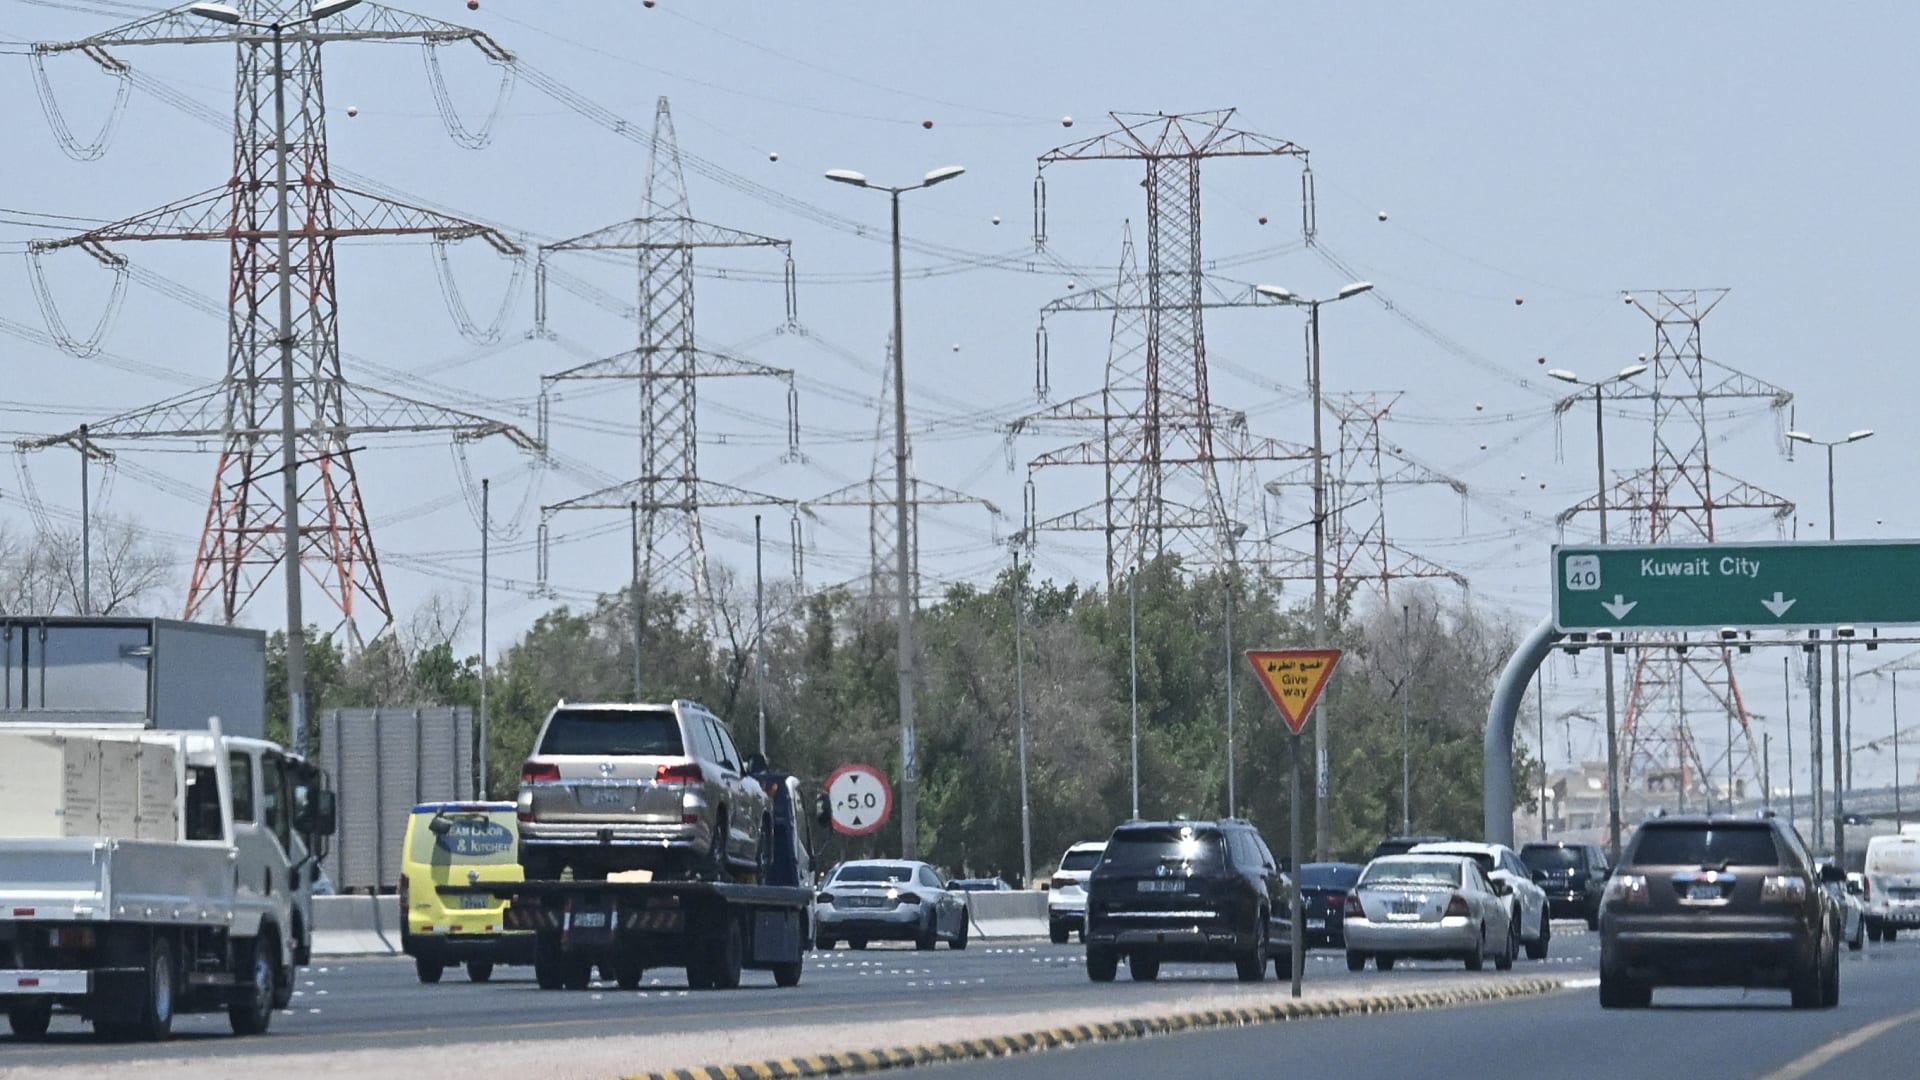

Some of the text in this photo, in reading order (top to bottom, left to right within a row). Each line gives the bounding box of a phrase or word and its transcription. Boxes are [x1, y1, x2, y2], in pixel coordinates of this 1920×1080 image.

[1641, 556, 1760, 578] Kuwait City
[1570, 571, 1596, 586] 40
[1281, 674, 1308, 685] Give
[1283, 687, 1308, 699] way
[456, 839, 467, 853] &
